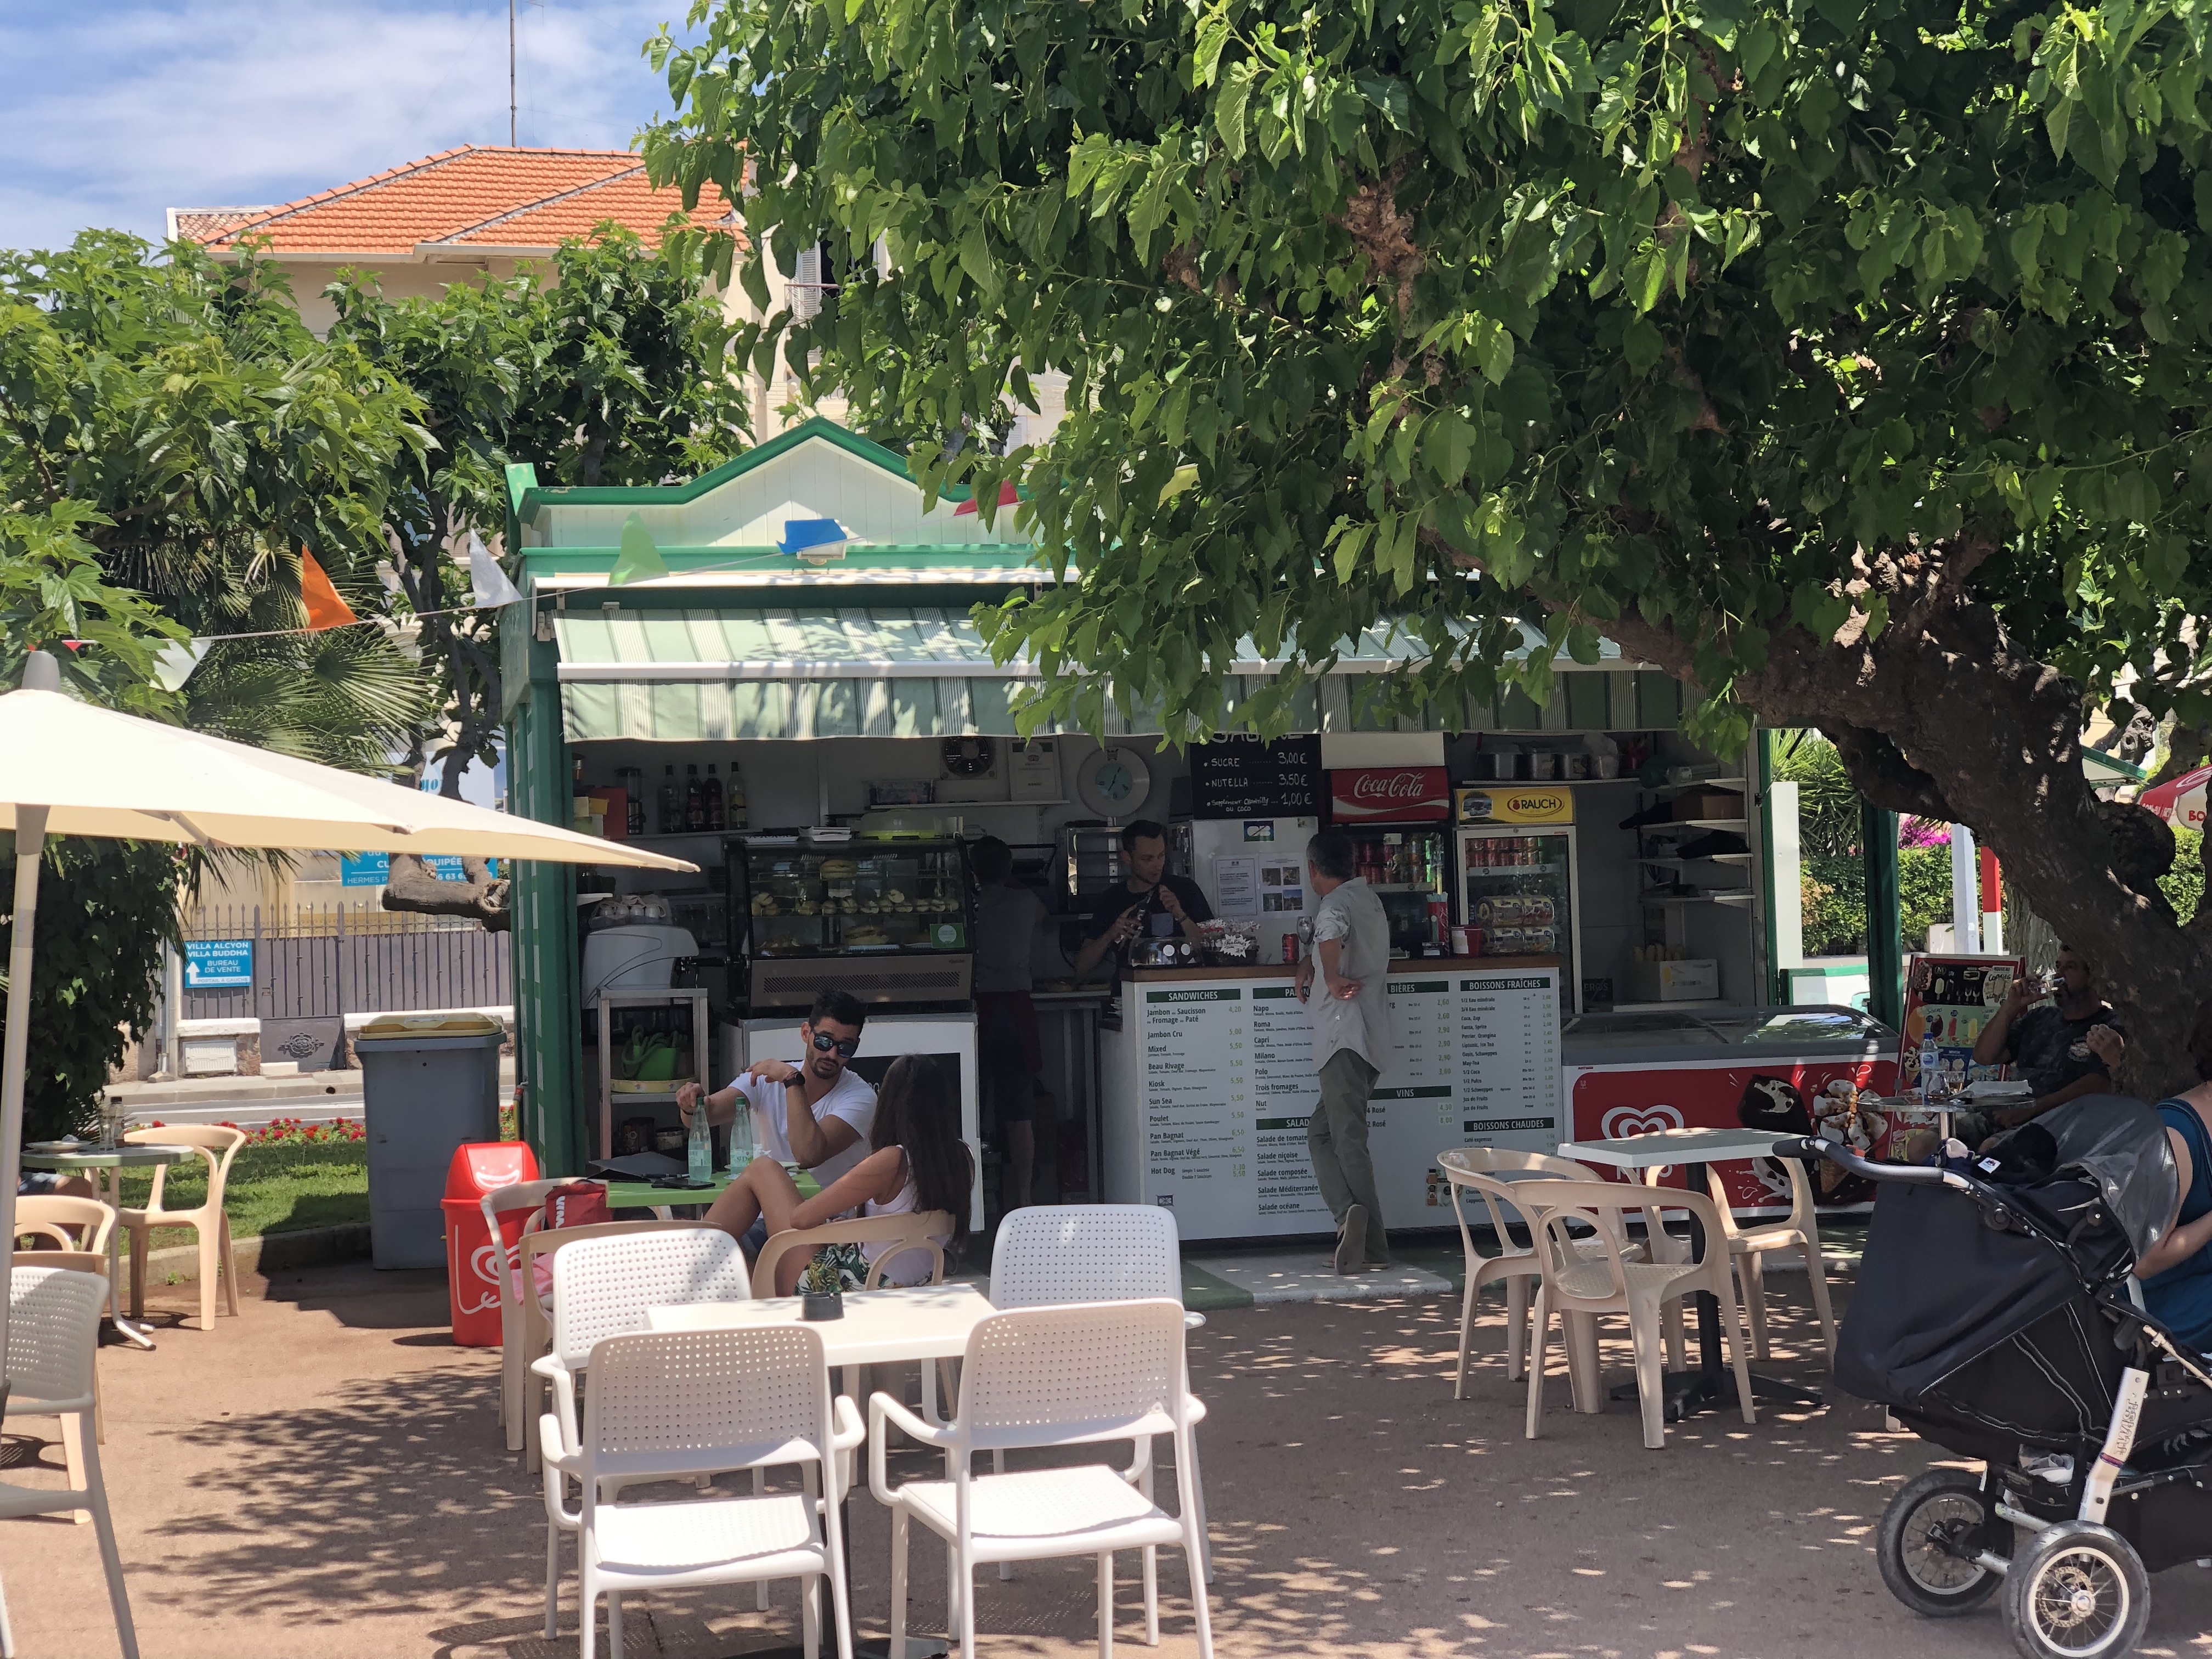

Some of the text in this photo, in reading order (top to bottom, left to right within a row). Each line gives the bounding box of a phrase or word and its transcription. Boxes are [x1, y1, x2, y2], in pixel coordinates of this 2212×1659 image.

[1211, 758, 1239, 766] SUCRE
[1212, 777, 1248, 787] NUTELLA
[1521, 799, 1556, 809] RAUCH
[1391, 983, 1415, 993] BIÈRES
[1469, 978, 1541, 990] BOISSONS FRAÎCHES
[1169, 991, 1218, 1001] SANDWICHES
[1147, 1009, 1170, 1017] Jambon
[1148, 1031, 1171, 1039] Jambon
[1254, 1036, 1269, 1045] Capri
[1165, 1063, 1184, 1071] Rivage
[1271, 1084, 1299, 1092] fromages
[1396, 1089, 1414, 1097] VINS
[1473, 1119, 1544, 1131] BOISSONS CHAUDES
[1163, 1132, 1184, 1140] Bagnat
[1164, 1149, 1184, 1158] Bagnat
[1186, 1148, 1200, 1157] Végé
[1163, 1167, 1175, 1175] Dog
[1278, 1168, 1307, 1176] composée
[1279, 1184, 1318, 1193] Méditerranée
